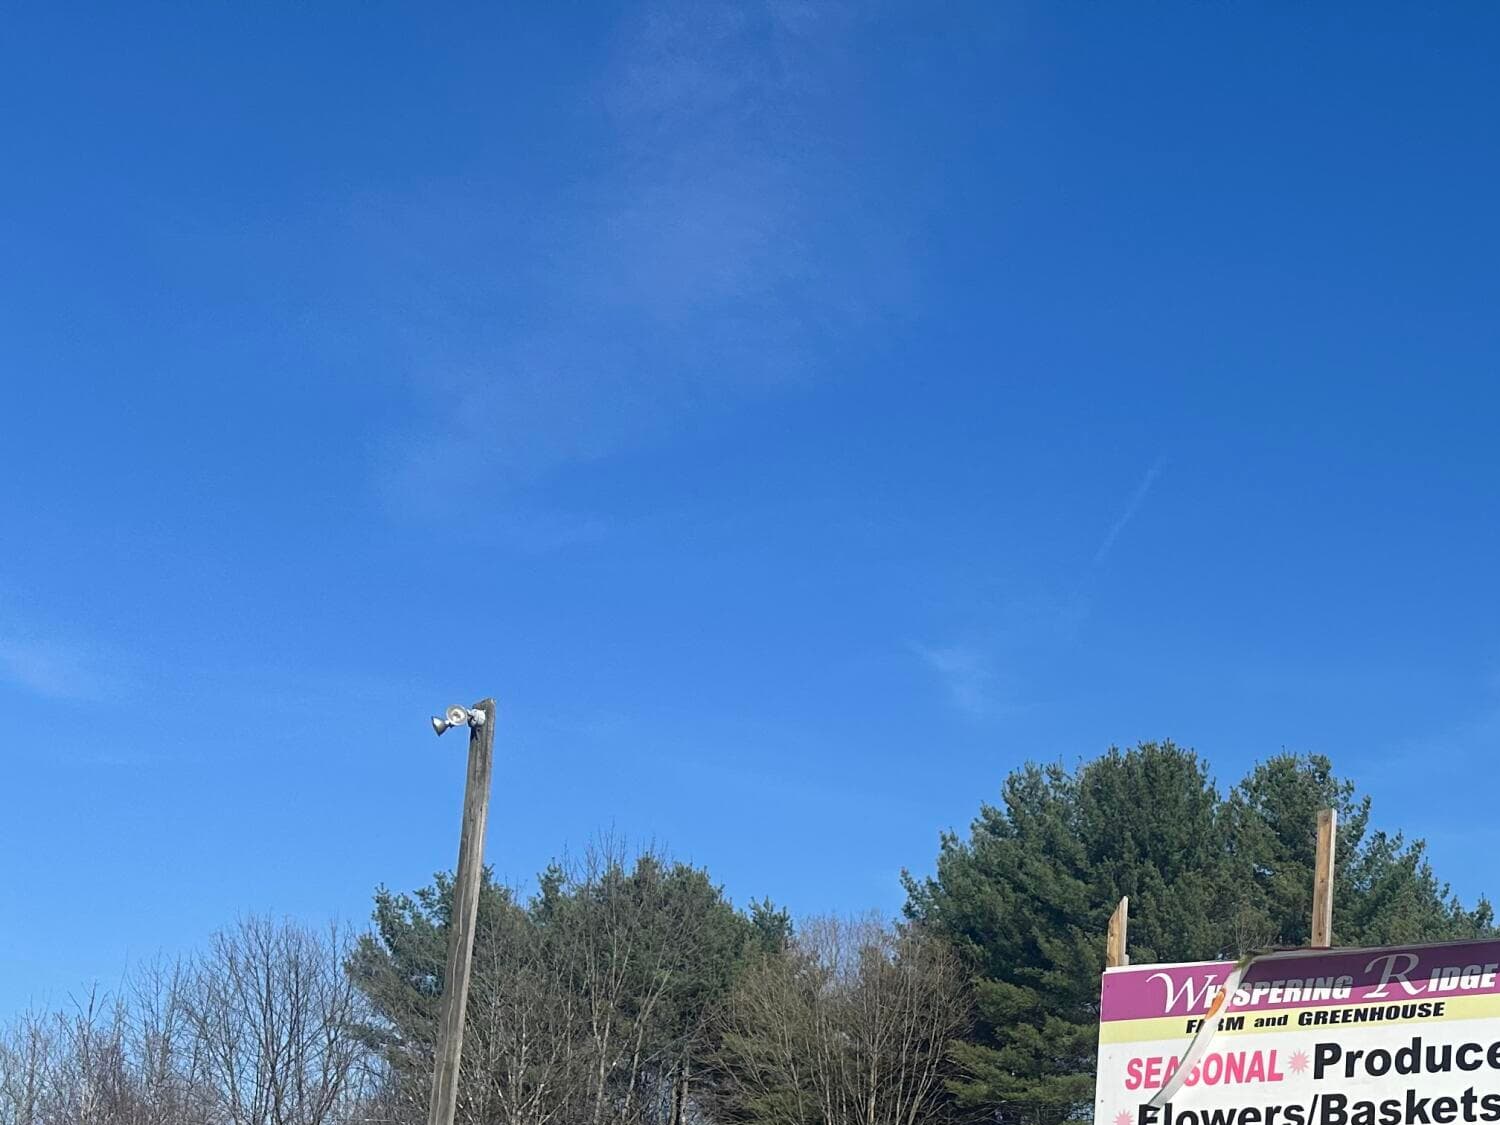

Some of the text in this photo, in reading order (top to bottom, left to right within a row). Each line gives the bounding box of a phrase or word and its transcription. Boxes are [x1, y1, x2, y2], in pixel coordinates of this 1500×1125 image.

[1146, 953, 1499, 1013] WHSPERING RIDGE
[1254, 1014, 1288, 1028] and
[1297, 1002, 1445, 1026] GREENHOUSE
